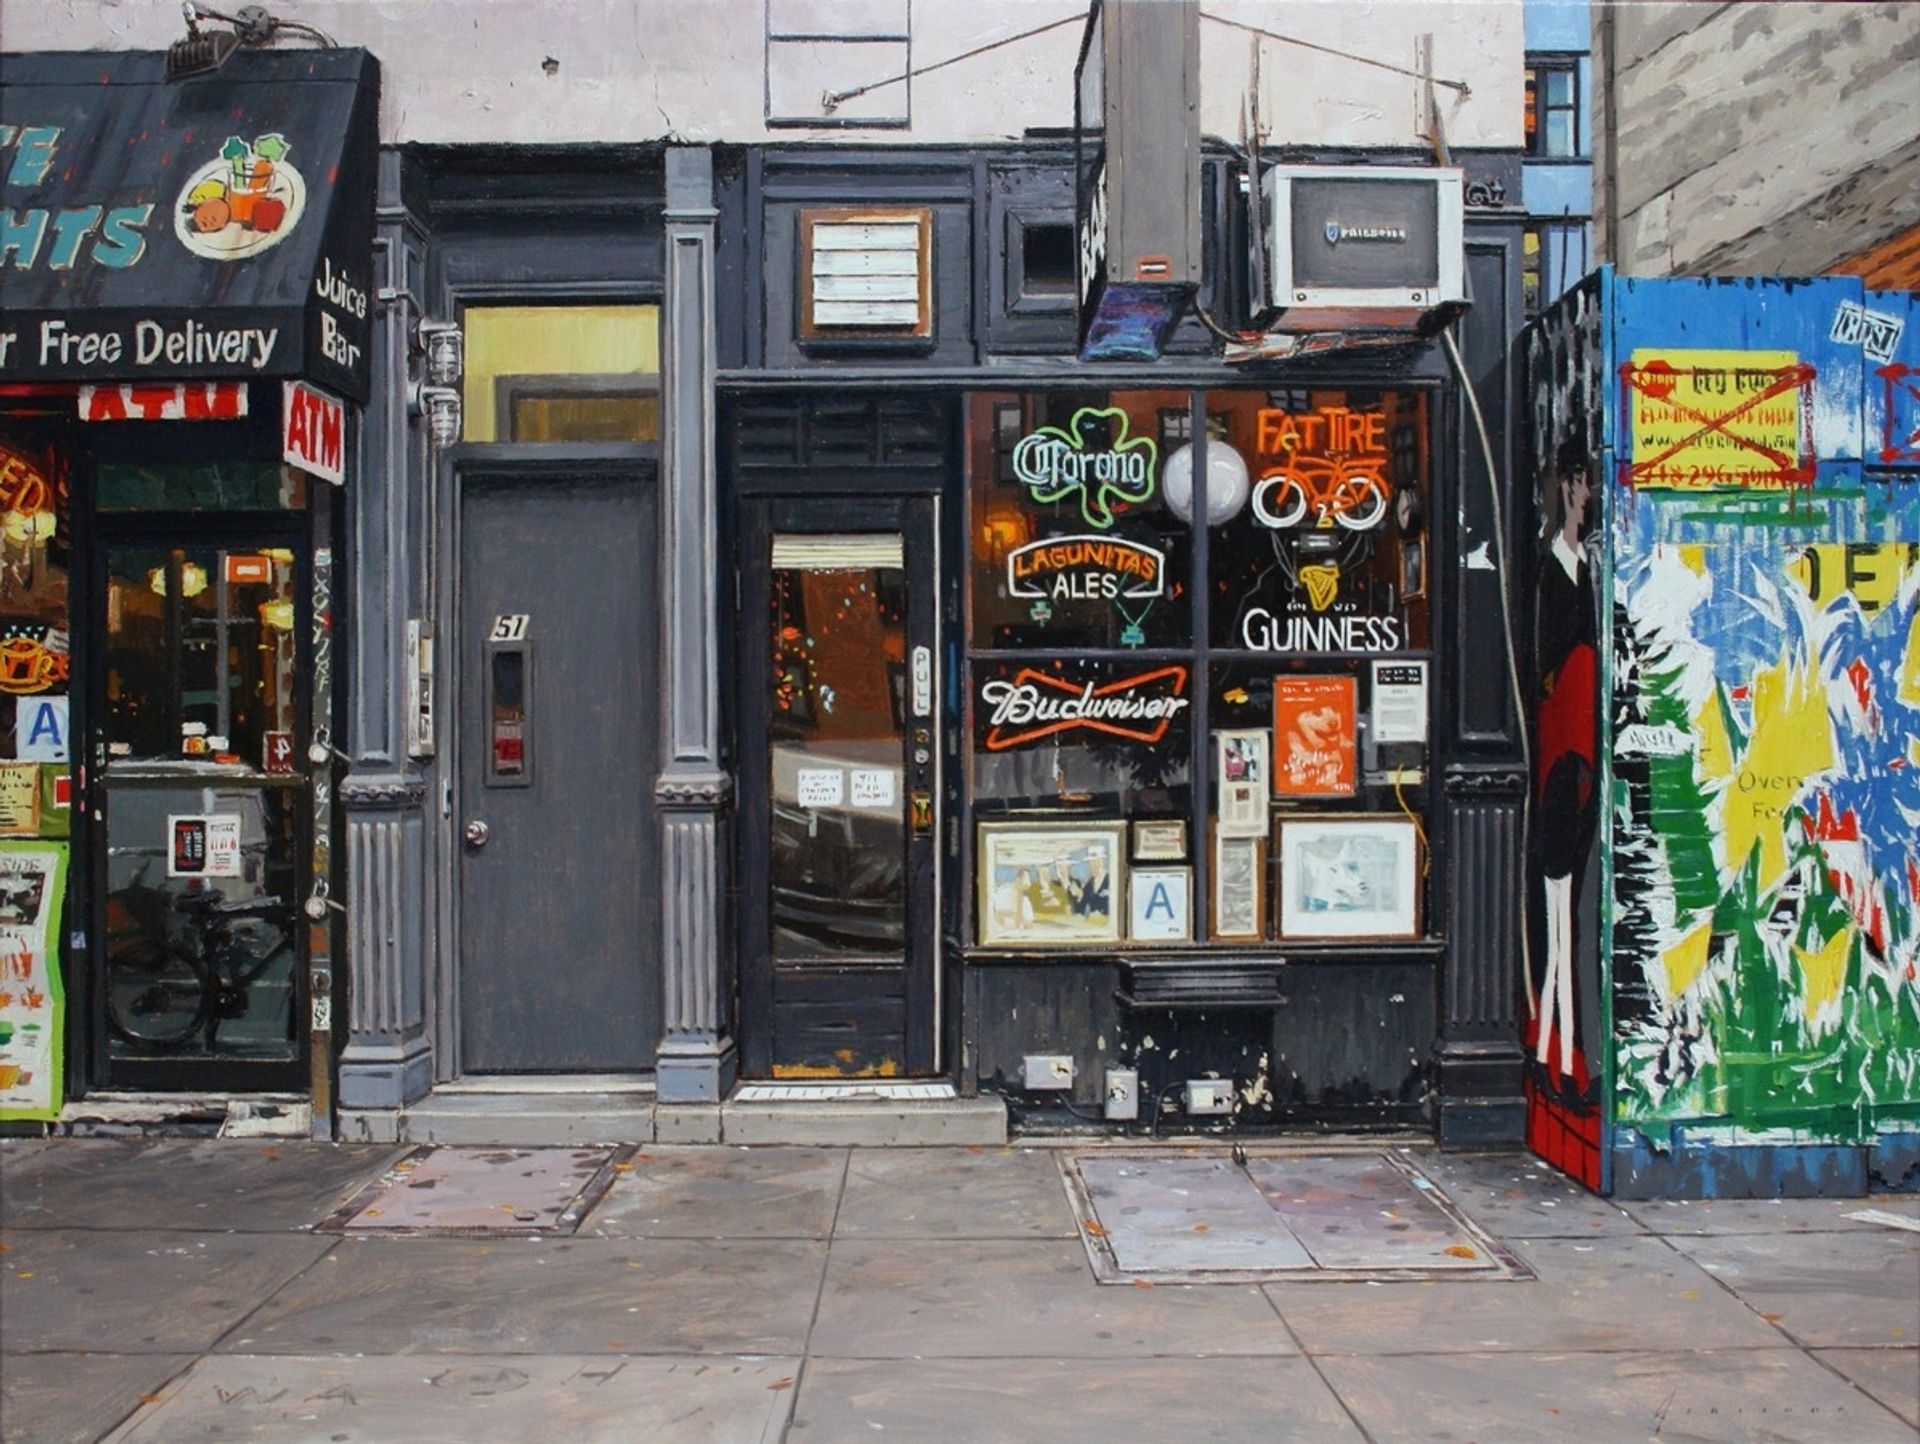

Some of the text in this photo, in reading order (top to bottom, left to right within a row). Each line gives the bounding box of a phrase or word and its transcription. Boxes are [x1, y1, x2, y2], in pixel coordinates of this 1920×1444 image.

[0, 203, 155, 271] HTS
[317, 257, 367, 320] Juice
[40, 320, 122, 365] Free
[135, 318, 279, 370] Delivery
[321, 318, 361, 368] Bar
[288, 386, 341, 473] ATM
[1257, 406, 1387, 454] FAT TIRE
[1013, 433, 1146, 489] Corona
[1015, 542, 1157, 583] LAGUNITAS
[1052, 572, 1119, 599] ALES
[495, 615, 524, 638] 51
[1243, 607, 1399, 651] GUINNESS
[915, 651, 929, 710] PULL
[981, 680, 1189, 725] Budweiser
[28, 702, 62, 745] A
[1144, 881, 1175, 920] A
